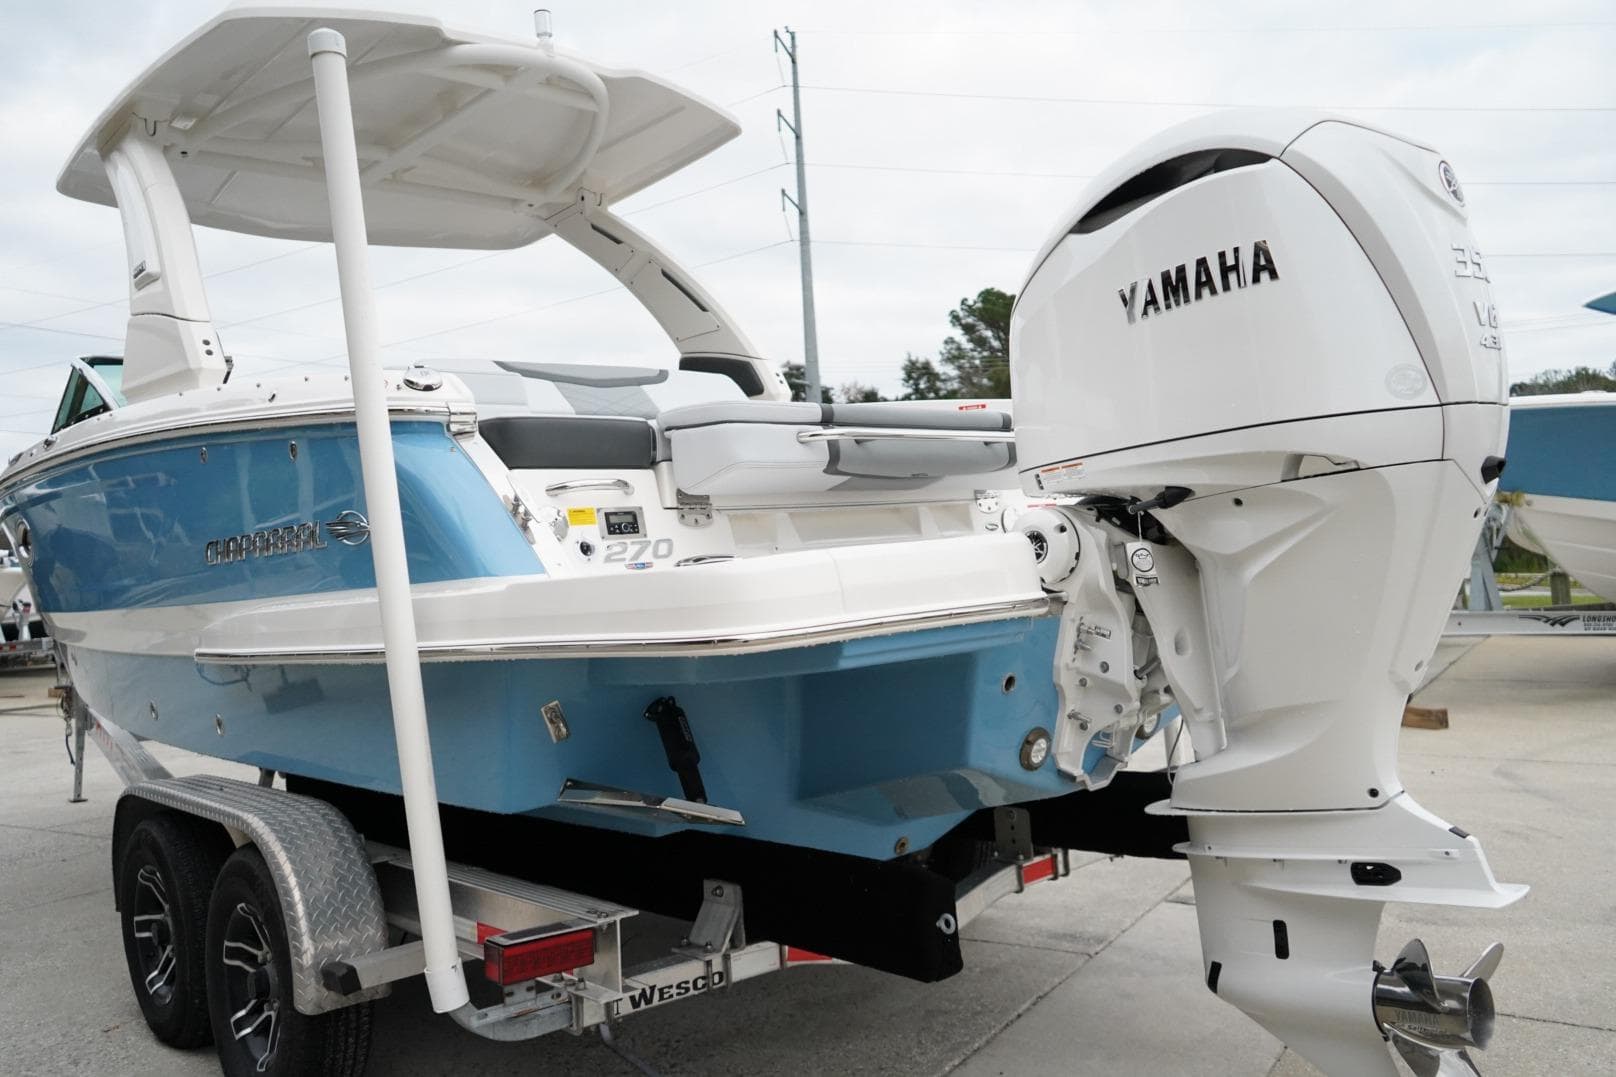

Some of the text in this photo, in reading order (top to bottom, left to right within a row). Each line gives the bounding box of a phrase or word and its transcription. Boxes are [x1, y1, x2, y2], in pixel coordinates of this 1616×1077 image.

[1118, 240, 1280, 326] YAMAHA
[205, 520, 328, 566] CHAPARRAL
[604, 538, 674, 563] 270
